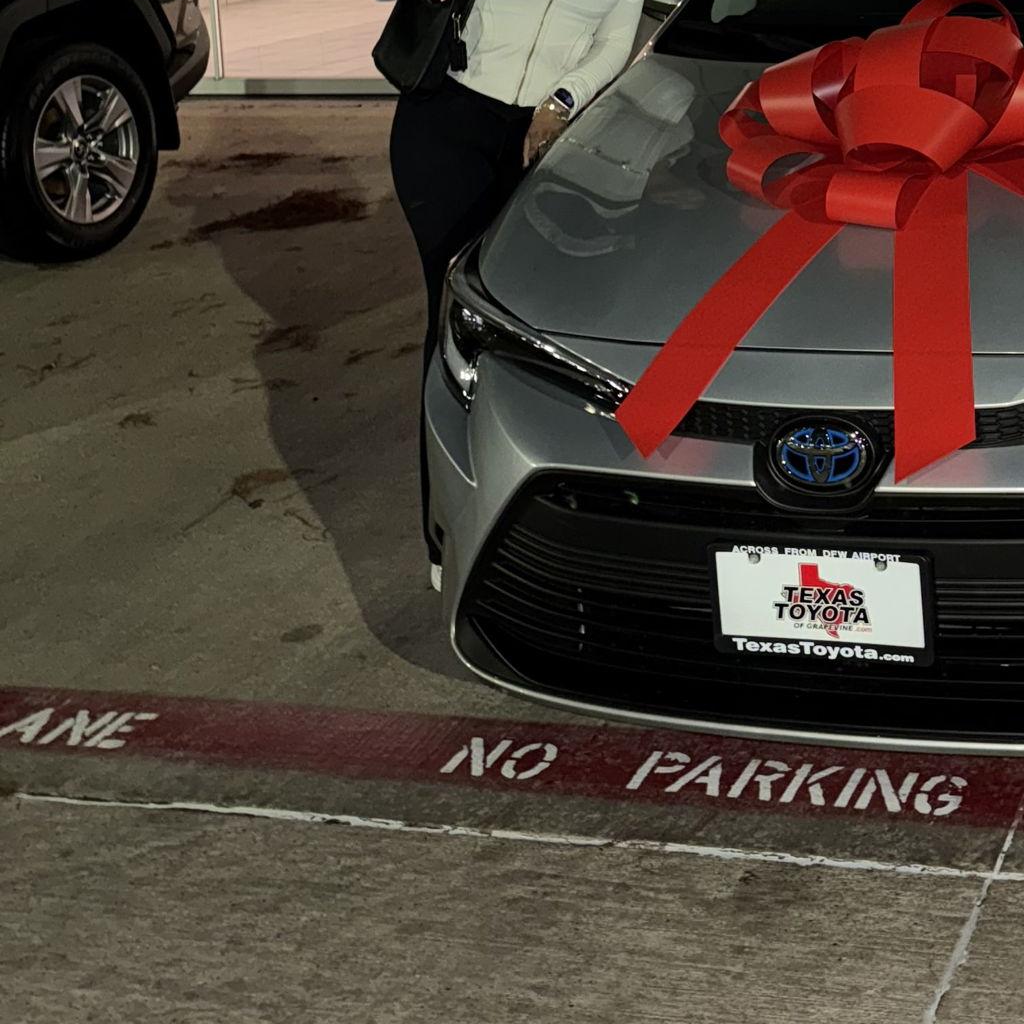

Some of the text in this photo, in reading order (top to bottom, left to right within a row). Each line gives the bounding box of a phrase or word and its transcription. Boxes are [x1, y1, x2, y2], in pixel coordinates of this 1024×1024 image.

[732, 545, 901, 563] ACROSS FROM DFW AIRPORT
[783, 586, 864, 607] TEXAS
[774, 603, 870, 624] TOYOTA
[731, 637, 915, 663] TexasToyota.com
[440, 736, 558, 780] NO
[625, 750, 968, 817] PARKING
